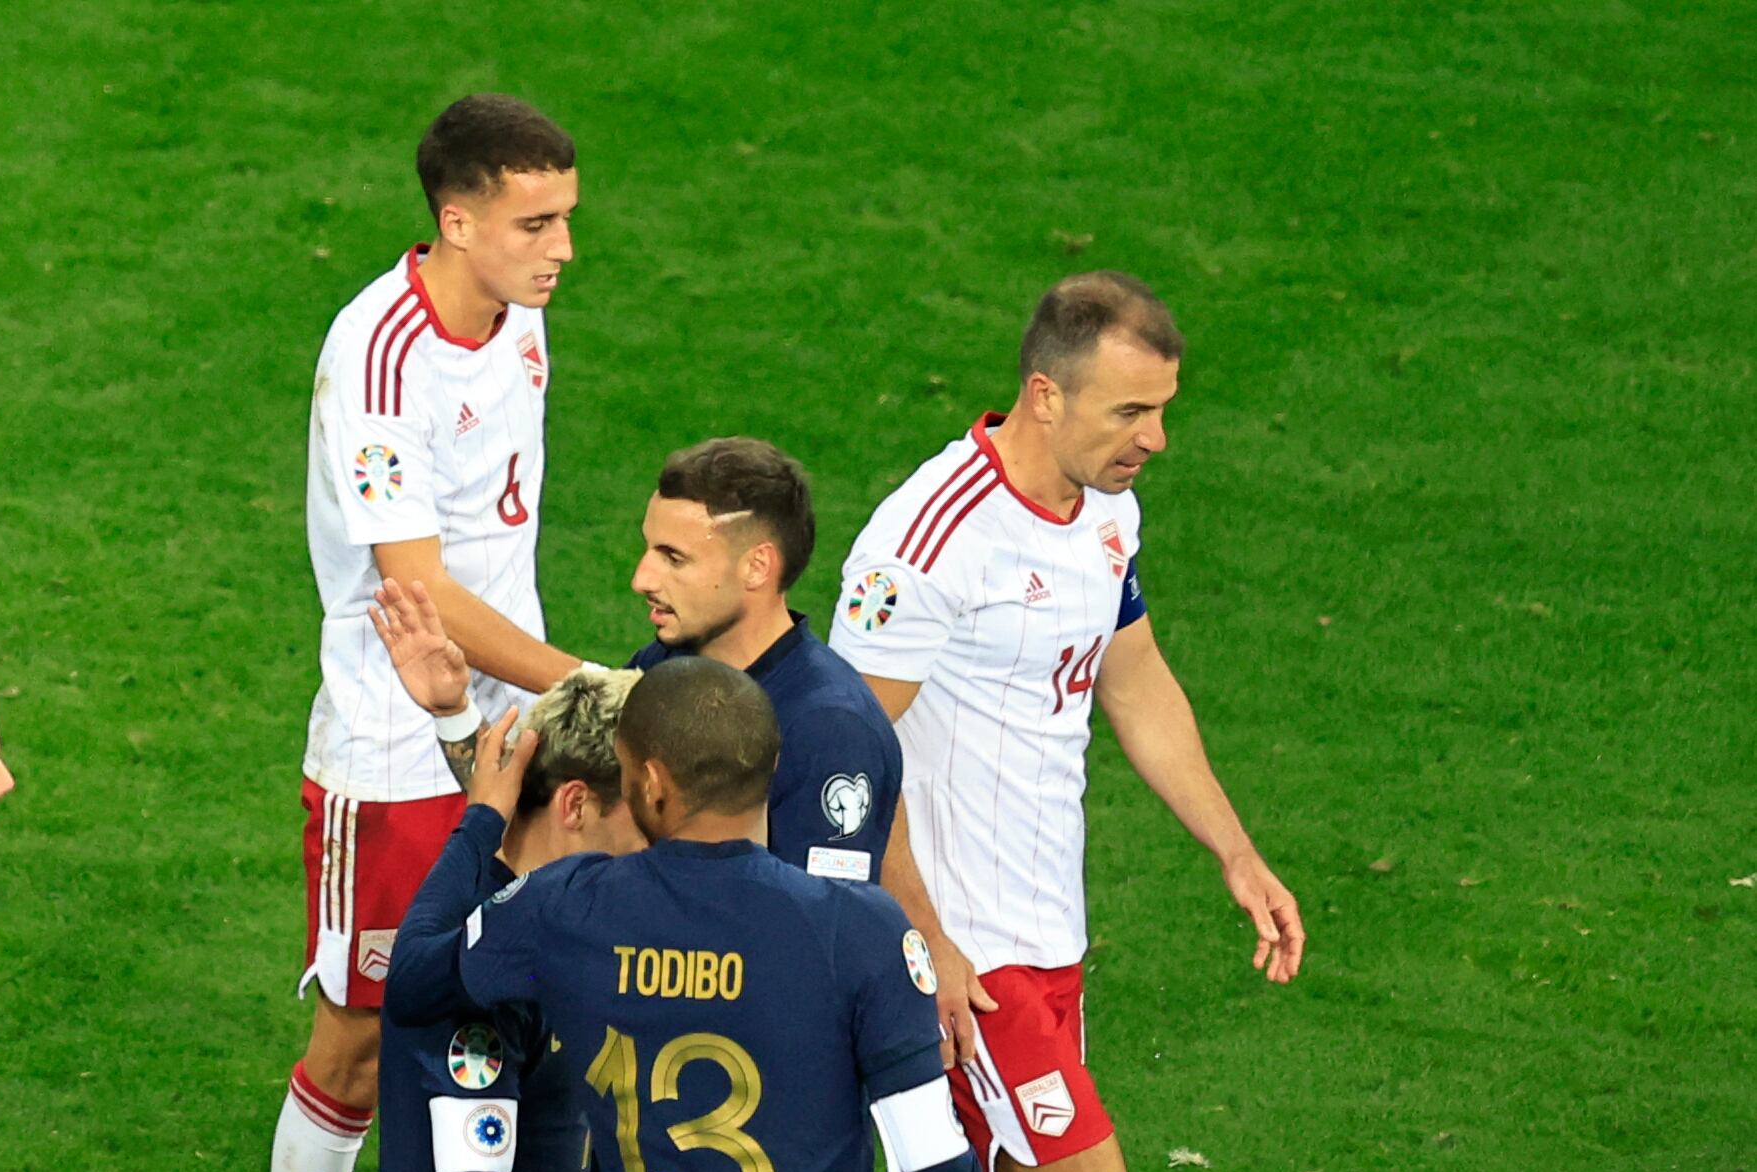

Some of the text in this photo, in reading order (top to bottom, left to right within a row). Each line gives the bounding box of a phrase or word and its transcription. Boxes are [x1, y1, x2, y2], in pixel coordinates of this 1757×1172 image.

[497, 452, 529, 526] 6
[1051, 634, 1103, 715] 14
[613, 946, 743, 1000] TODIBO
